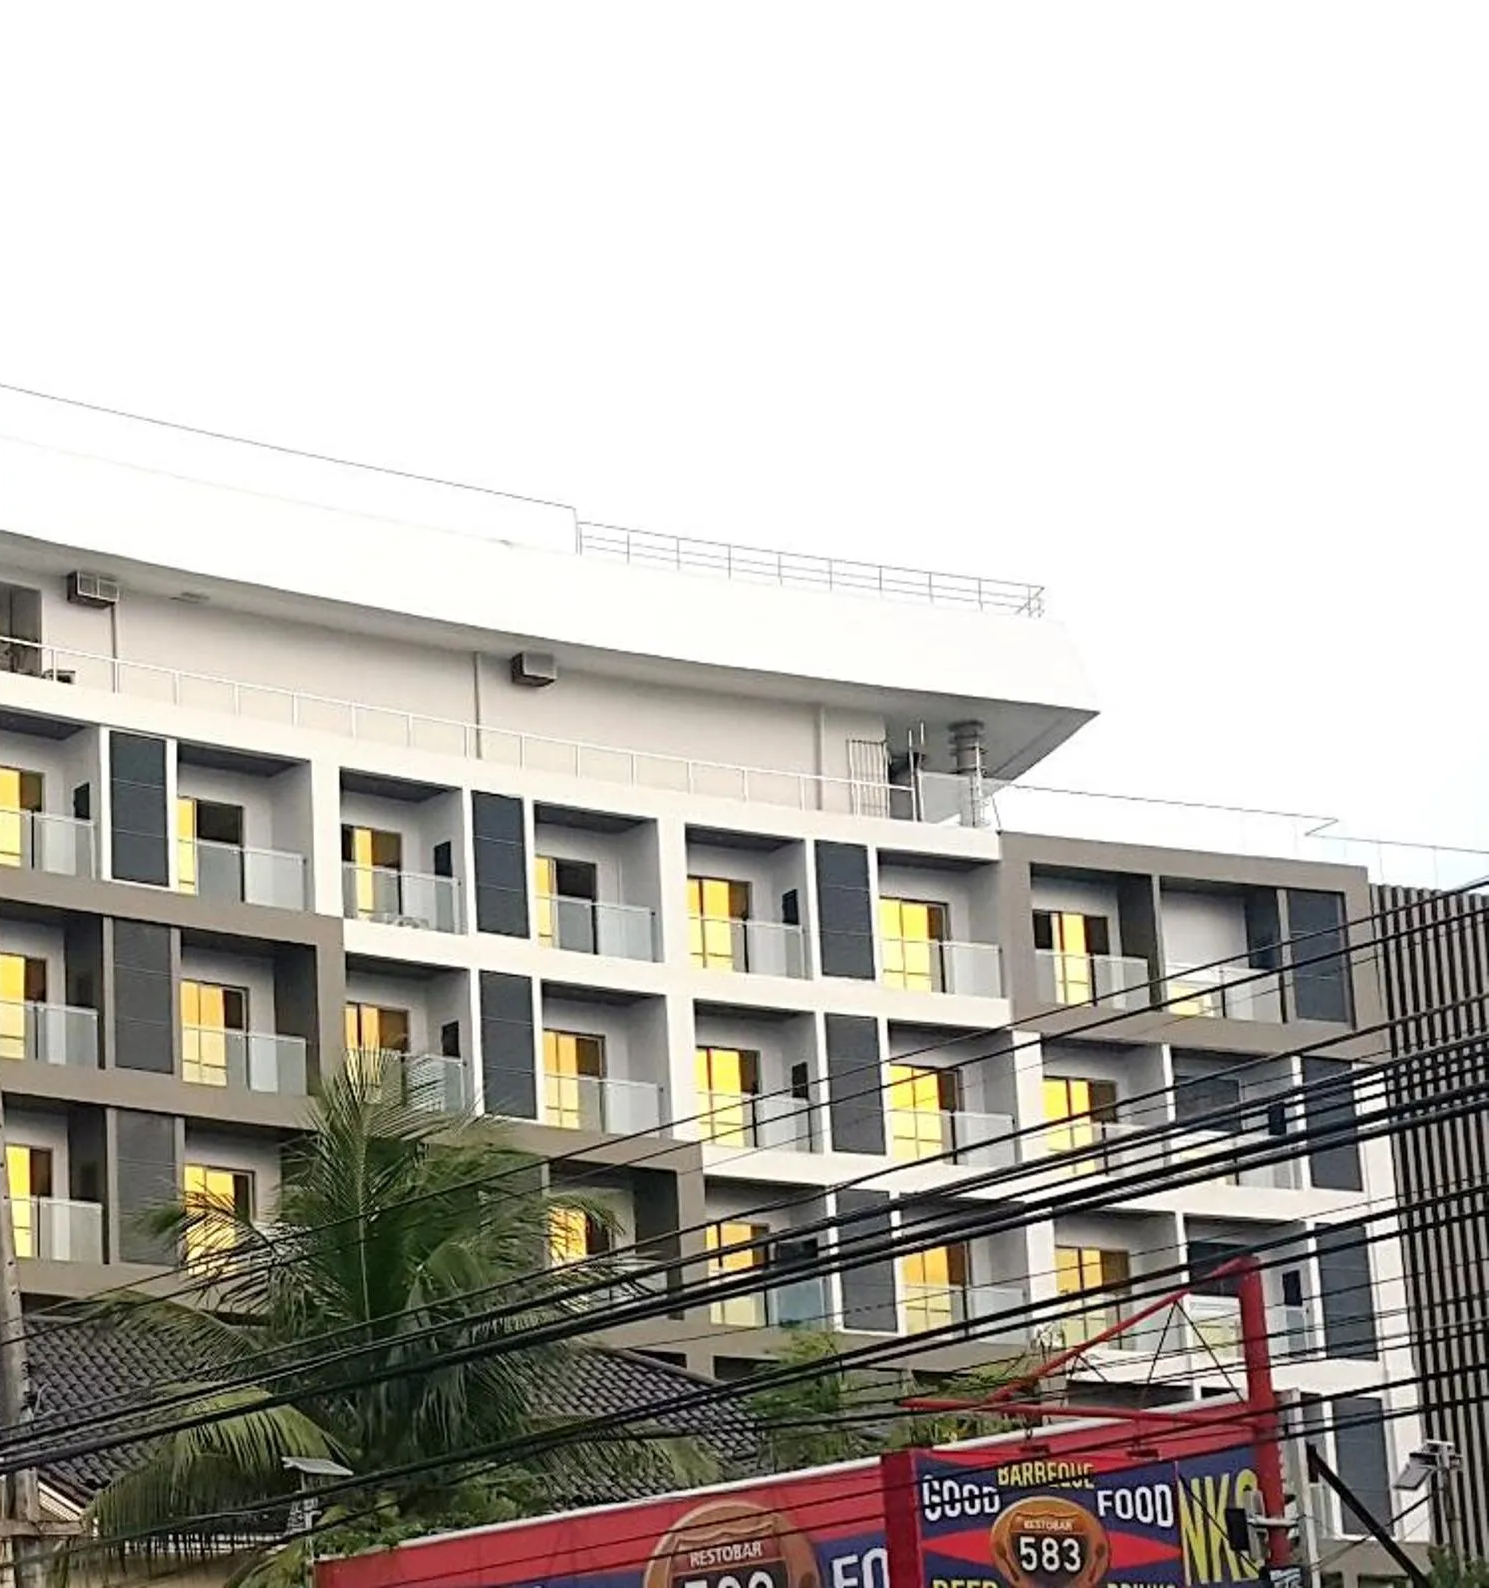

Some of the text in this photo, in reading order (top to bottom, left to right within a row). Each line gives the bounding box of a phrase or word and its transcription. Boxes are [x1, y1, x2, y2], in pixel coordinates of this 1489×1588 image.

[922, 1474, 1174, 1527] GOOD FOOD
[689, 1541, 763, 1568] RESTOBAR
[1019, 1536, 1082, 1573] 583
